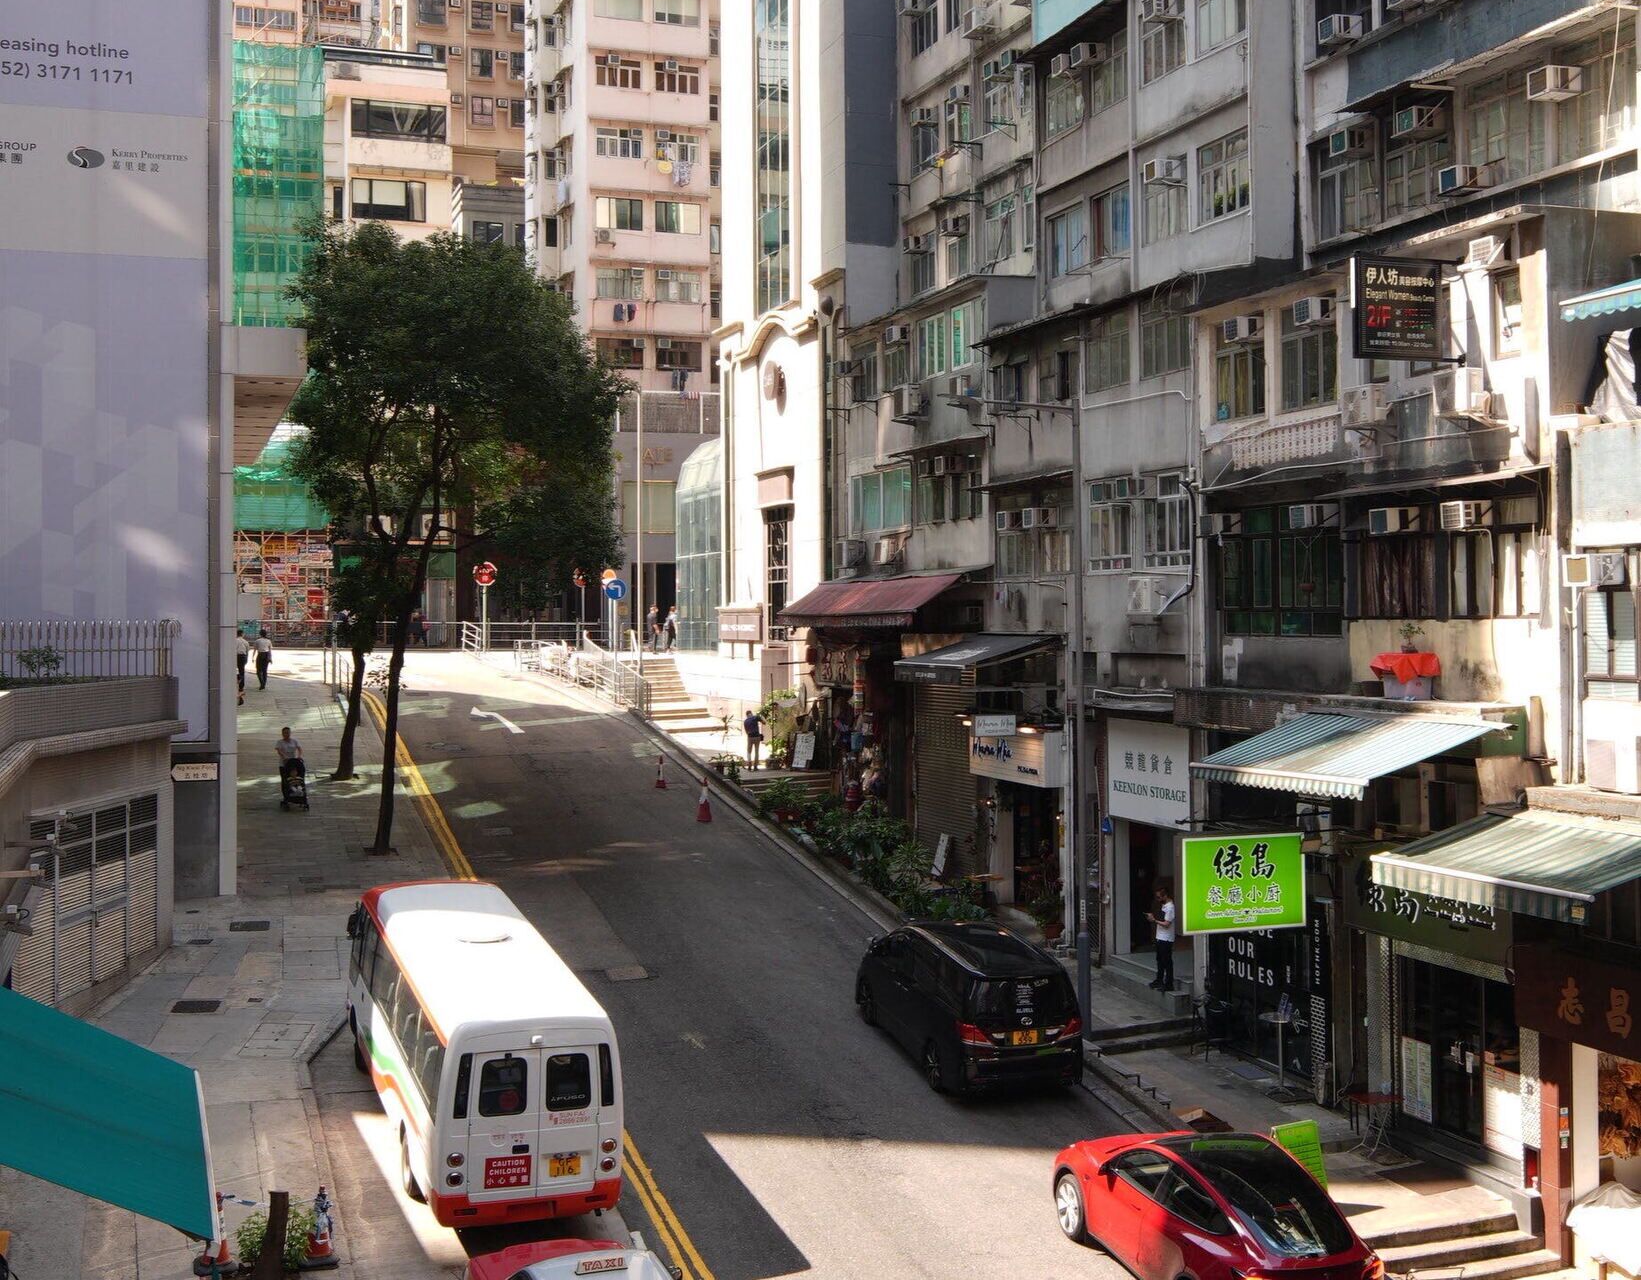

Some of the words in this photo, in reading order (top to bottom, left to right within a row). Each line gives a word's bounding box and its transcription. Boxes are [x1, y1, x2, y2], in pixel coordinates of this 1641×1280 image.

[0, 38, 59, 57] easing
[66, 40, 129, 60] hotline
[1, 61, 30, 79] 52)
[37, 64, 81, 81] 3171
[90, 68, 133, 85] 1171
[1366, 267, 1398, 286] 伊人坊
[1366, 288, 1387, 301] Elegant
[1388, 290, 1409, 301] Women
[1367, 305, 1392, 327] 2/F
[1113, 780, 1148, 797] KEENLON
[1150, 785, 1187, 803] STORAGE
[1228, 936, 1255, 959] OUR
[1228, 958, 1274, 987] RULES
[557, 1093, 586, 1101] FUSO
[489, 1167, 527, 1176] CHILDREN
[492, 1159, 525, 1167] CAUTION
[582, 1257, 624, 1271] TAXI
